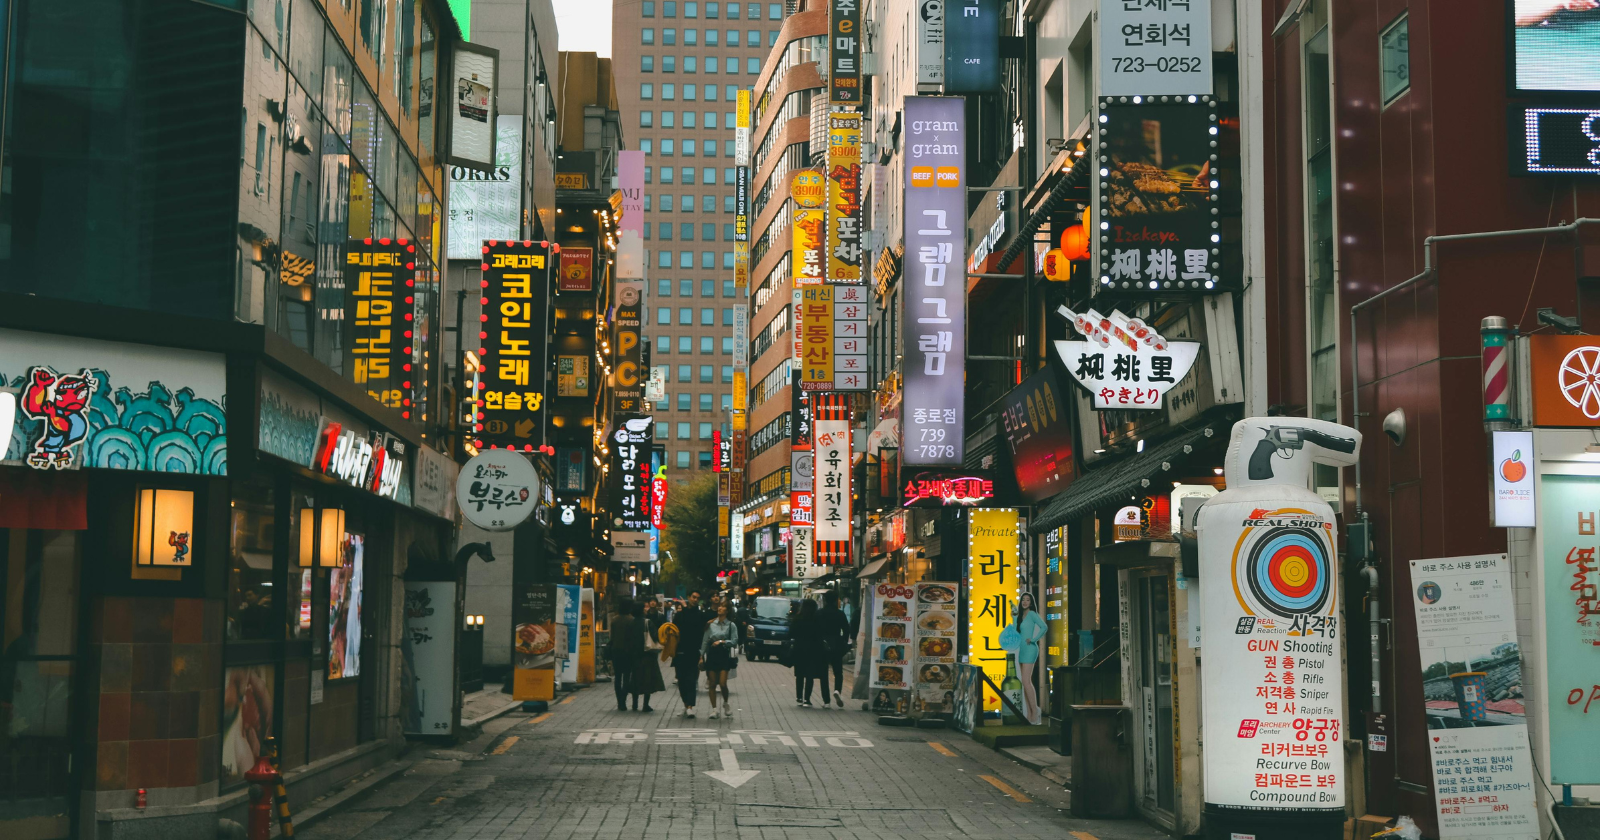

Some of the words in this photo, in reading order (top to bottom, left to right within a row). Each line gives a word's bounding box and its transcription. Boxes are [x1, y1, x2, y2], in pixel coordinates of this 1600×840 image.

[1122, 23, 1190, 46] 연회석
[1112, 57, 1201, 73] 723-0252
[912, 120, 958, 134] gram
[912, 143, 958, 158] gram
[622, 188, 641, 200] MJ
[492, 254, 545, 269] 고래고래
[805, 289, 831, 301] 대신
[918, 209, 953, 376] 그램그램
[499, 273, 532, 385] 코인노래
[805, 304, 830, 365] 부동산
[485, 390, 543, 411] 연습장
[1099, 387, 1159, 405] やきとり
[621, 400, 633, 409] 3F
[913, 408, 956, 424] 종로점
[920, 428, 946, 442] 739
[824, 450, 842, 527] 육회지존
[904, 480, 994, 498] 소갈비3종세트
[468, 481, 523, 512] 부루스
[973, 525, 1016, 538] Private
[1422, 565, 1437, 573] 바로
[1440, 563, 1454, 572] 주스
[1457, 562, 1472, 570] 사용
[1474, 560, 1497, 569] 설명서
[1289, 615, 1337, 639] 사격장
[1247, 640, 1279, 652] GUN
[1283, 640, 1333, 656] Shooting
[1299, 659, 1324, 669] Pistol
[1302, 674, 1324, 684] Rifle
[1256, 686, 1296, 699] 저격총
[1300, 689, 1329, 701] Sniper
[1300, 706, 1322, 716] Rapid
[1323, 706, 1334, 715] Fire
[1292, 718, 1340, 742] 양궁장
[1261, 743, 1329, 758] 리커브보우
[1256, 758, 1307, 770] Recurve
[1310, 759, 1331, 770] Bow
[1435, 758, 1470, 767] #바로주스
[1472, 757, 1487, 765] 먹고
[1490, 755, 1513, 764] 힘내서
[1436, 768, 1452, 776] 바로
[1465, 766, 1488, 774] 합격해
[1490, 764, 1513, 773] 친구야
[1255, 773, 1312, 789] 컴파운드
[1316, 774, 1336, 789] 보우
[1438, 777, 1458, 786] #바로
[1460, 777, 1475, 785] 주스
[1477, 776, 1493, 784] 먹고
[1250, 790, 1316, 804] Compound
[1319, 792, 1337, 802] Bow
[1439, 786, 1458, 794] #바로
[1440, 796, 1476, 806] #바로주스
[1493, 804, 1509, 812] 하자
